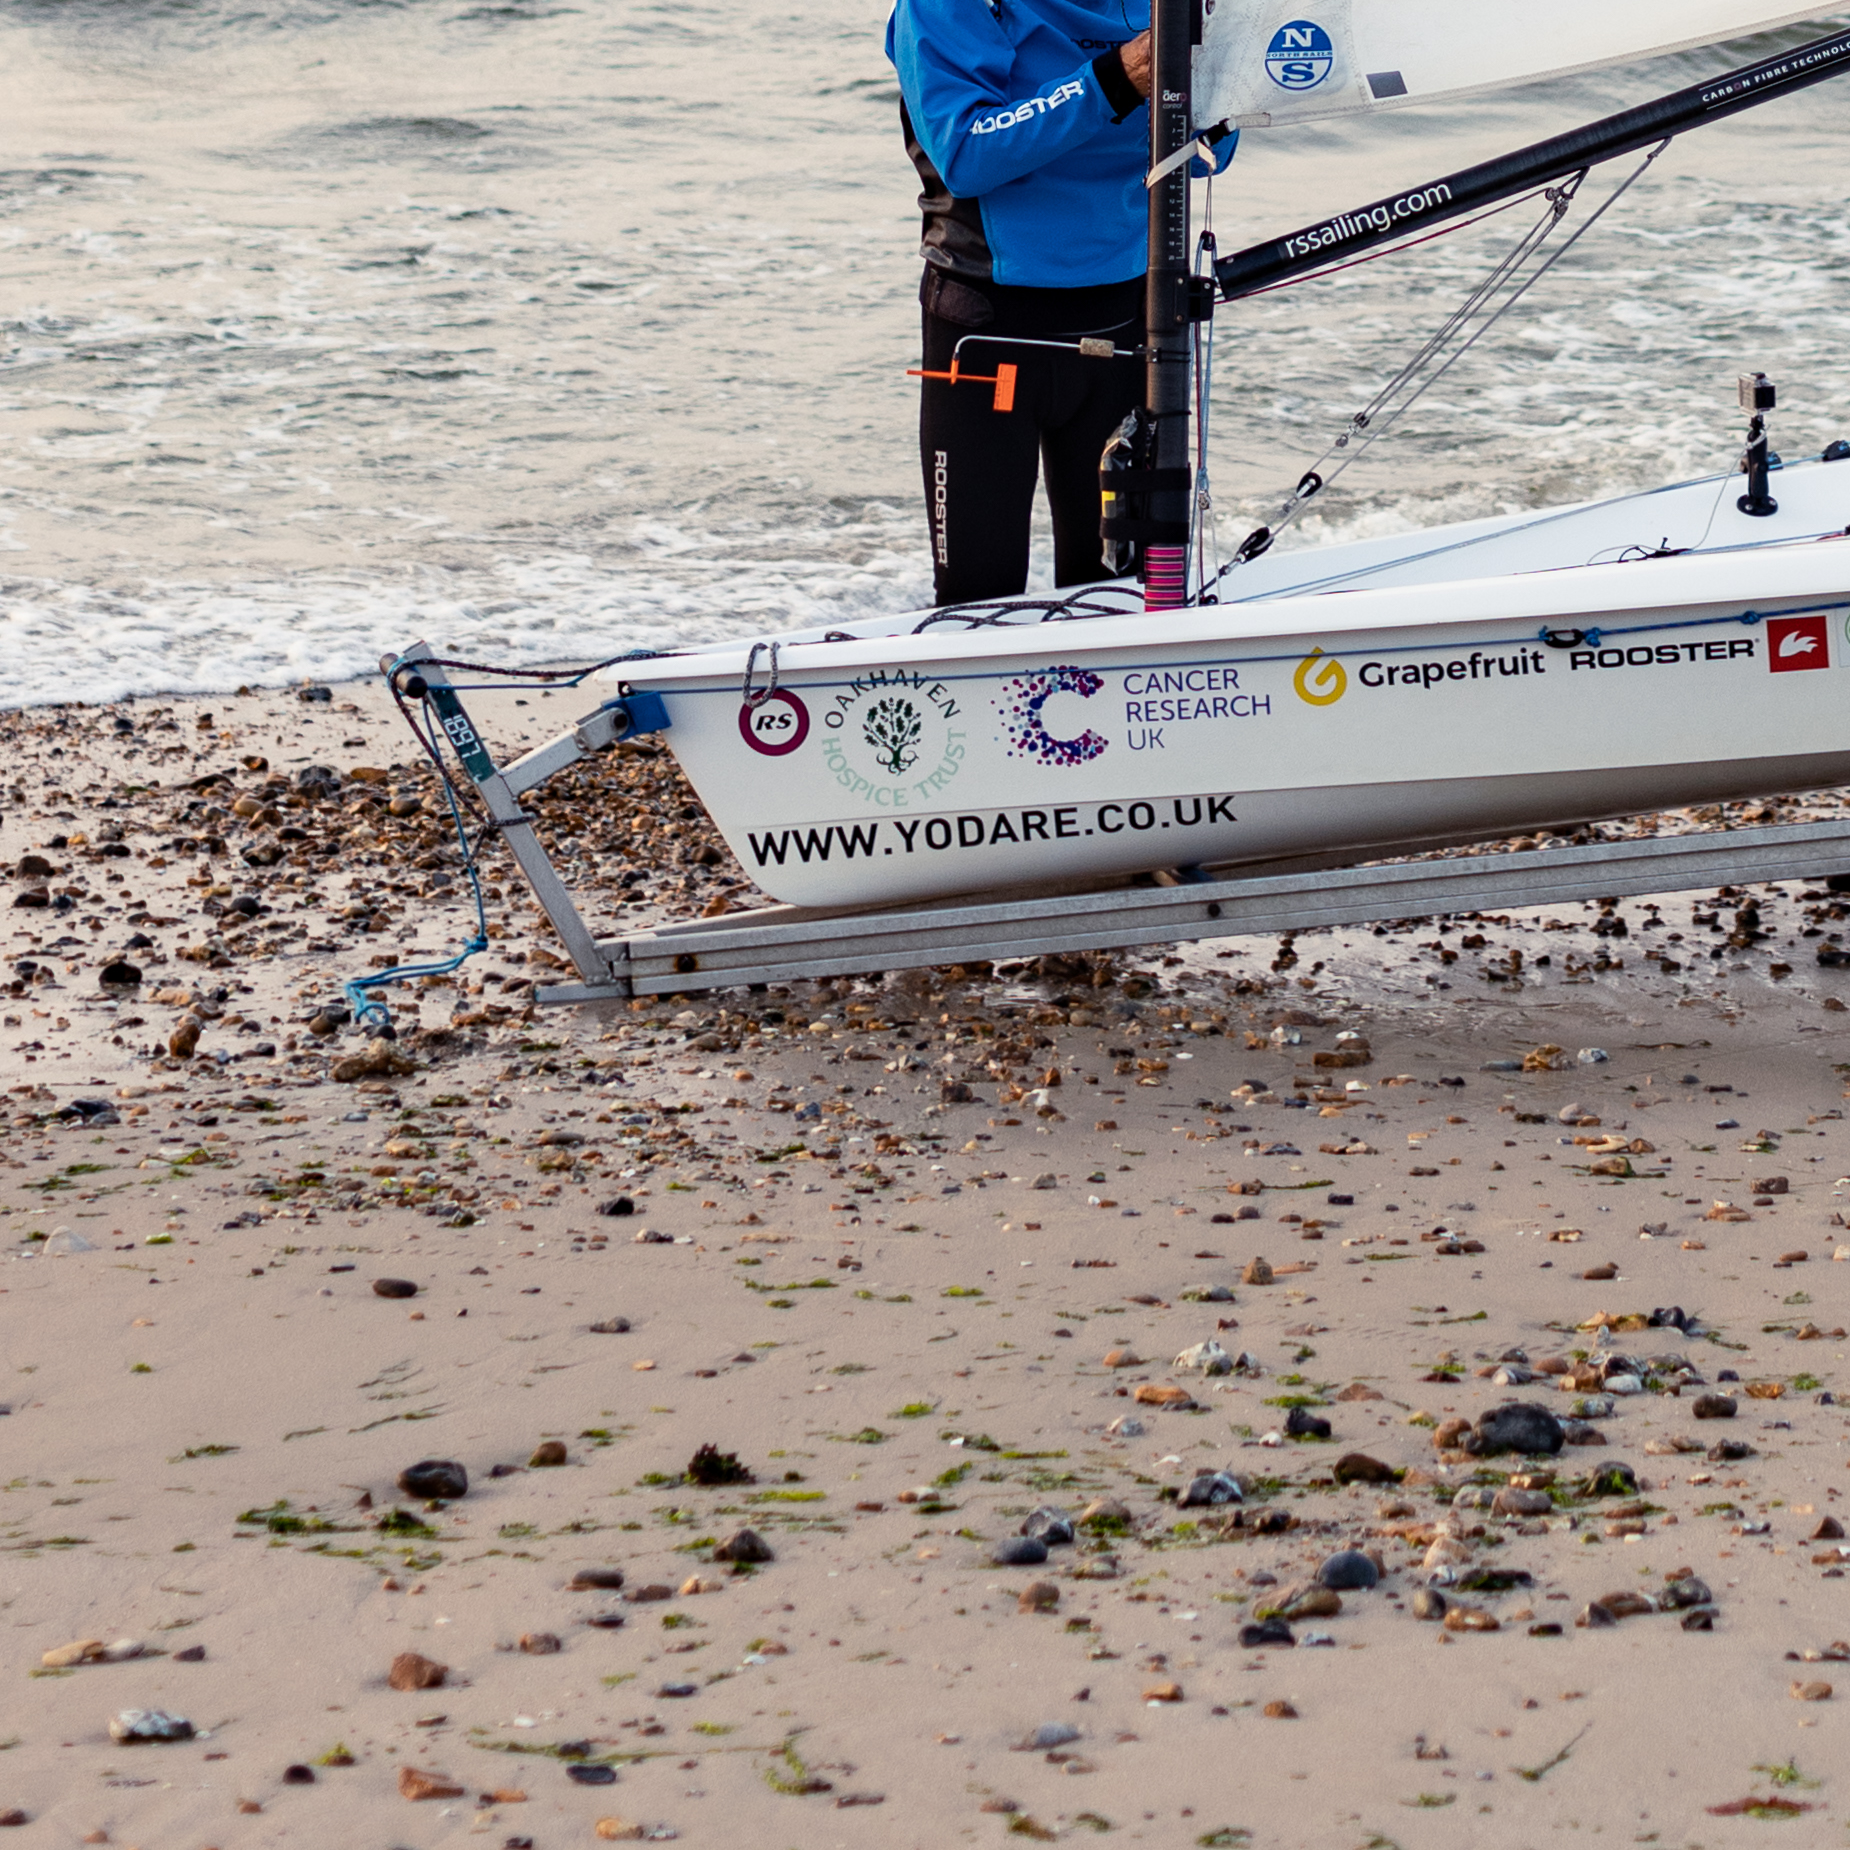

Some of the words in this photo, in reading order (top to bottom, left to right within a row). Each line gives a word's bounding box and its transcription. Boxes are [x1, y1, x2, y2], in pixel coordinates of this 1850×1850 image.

[1281, 28, 1316, 48] N
[1282, 62, 1315, 82] S
[1702, 79, 1751, 102] CARBON
[1754, 65, 1789, 83] FIBRE
[1284, 179, 1452, 259] rssailing.com
[935, 450, 948, 564] ROOSTER
[1358, 649, 1546, 689] Grapefruit
[1570, 639, 1755, 671] ROOSTER
[825, 669, 962, 730] OAKHAVEN
[1123, 668, 1240, 696] CANCER
[755, 711, 793, 731] RS
[1126, 695, 1271, 724] RESEARCH
[443, 714, 481, 759] 1897
[1127, 728, 1166, 751] UK
[822, 736, 909, 807] HOSPICE
[913, 727, 968, 801] TRUST
[747, 795, 1239, 867] WWW.YODARE.CO.UK
